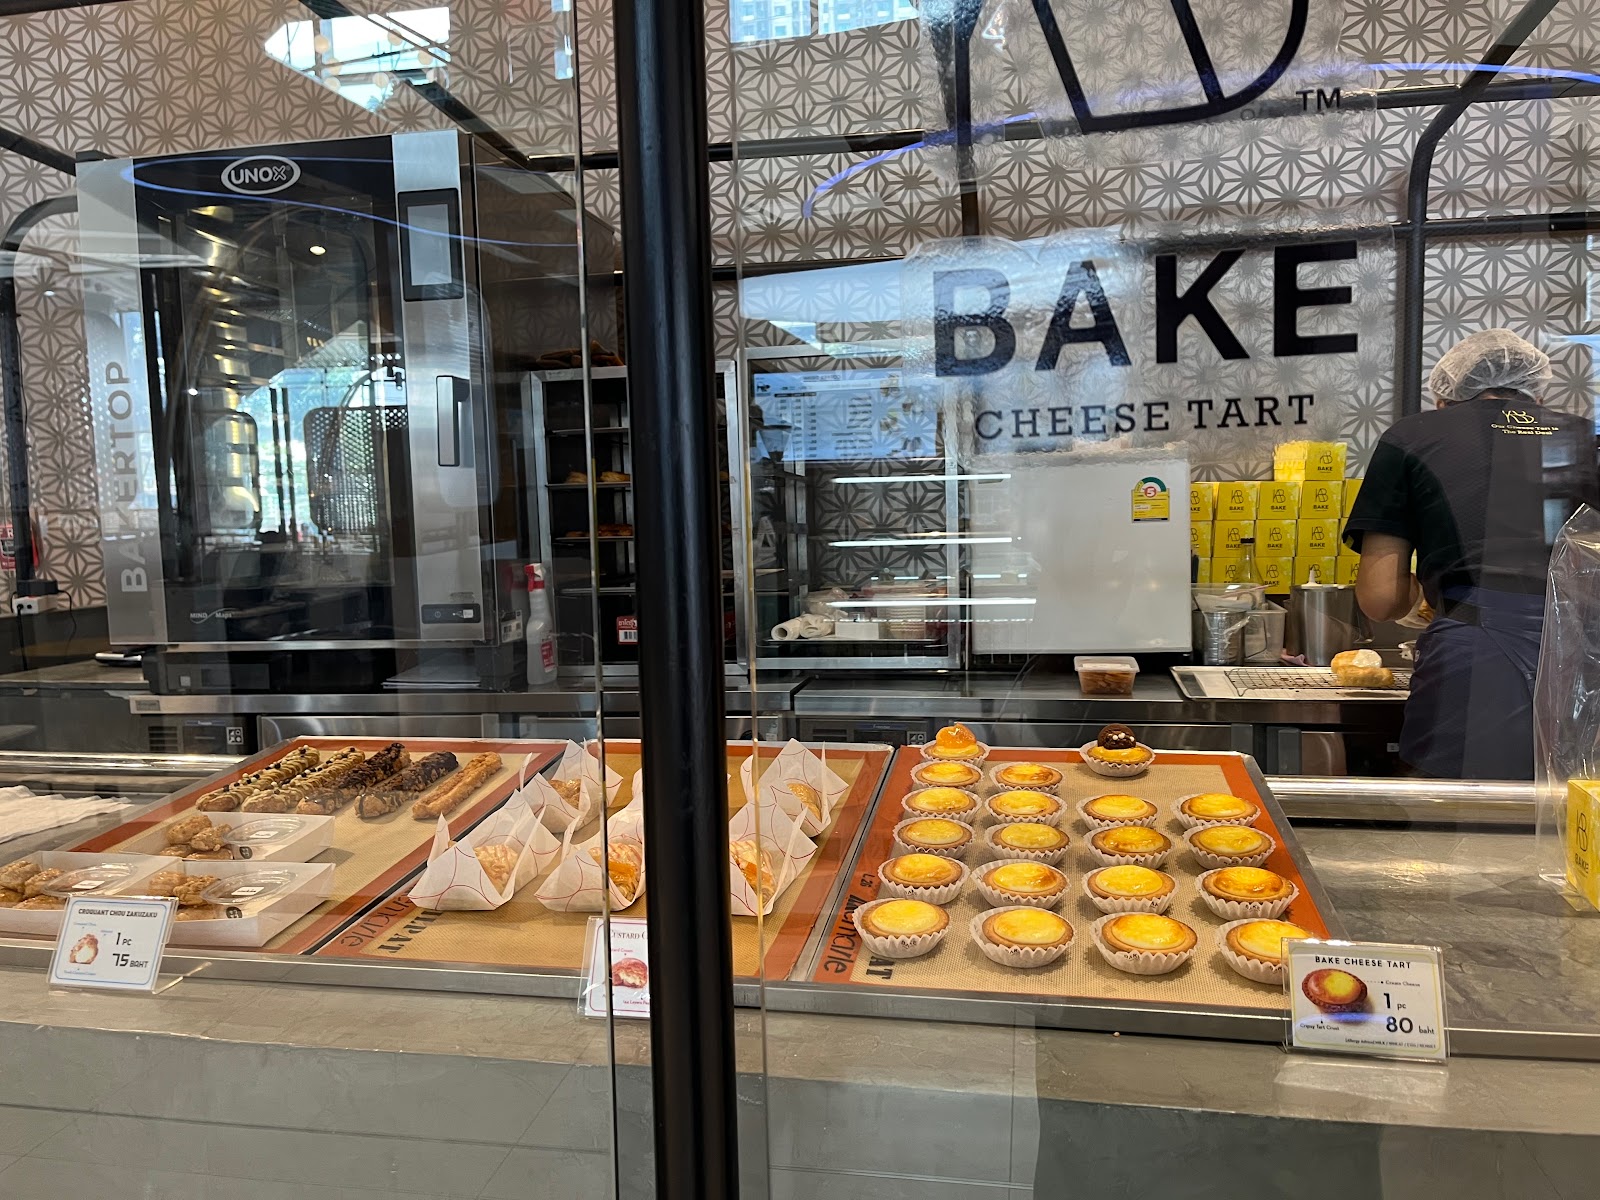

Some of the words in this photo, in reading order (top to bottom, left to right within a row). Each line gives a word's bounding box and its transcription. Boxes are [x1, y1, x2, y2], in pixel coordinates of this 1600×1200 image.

[230, 165, 287, 185] UNOX
[933, 239, 1358, 378] BAKE
[975, 401, 1170, 440] CHEESE
[1187, 394, 1315, 430] TART
[105, 361, 148, 592] BAKERTOP
[78, 908, 109, 916] CROQUANT
[116, 932, 121, 945] 1
[112, 953, 130, 967] 75
[129, 960, 148, 968] BAHT
[1315, 956, 1340, 965] BAKE
[1344, 957, 1382, 967] CHEESE
[1388, 960, 1411, 969] TART
[1383, 992, 1391, 1009] 1
[1397, 1003, 1407, 1011] pc
[1386, 1016, 1413, 1034] 80
[1418, 1025, 1435, 1035] baht
